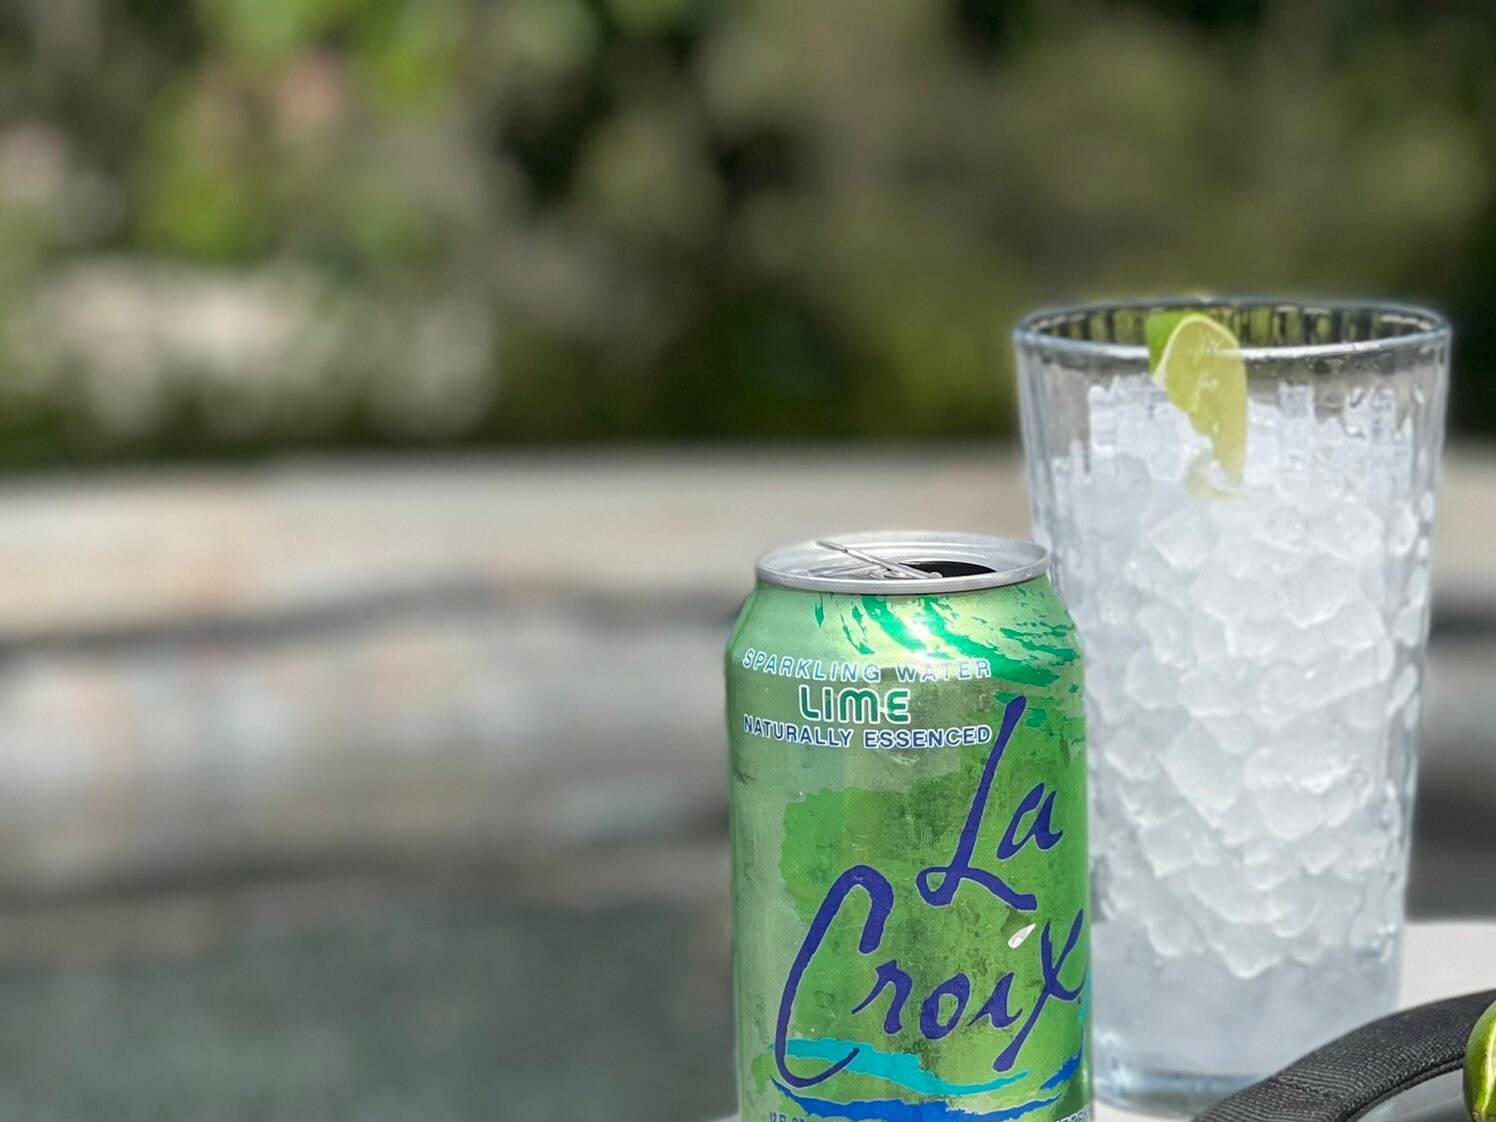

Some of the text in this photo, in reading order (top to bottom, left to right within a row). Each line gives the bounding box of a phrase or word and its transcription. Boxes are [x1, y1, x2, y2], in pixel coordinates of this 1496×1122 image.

[743, 648, 992, 682] SPARKLING WATER
[798, 684, 911, 724] LIME
[743, 713, 993, 749] NATURALLY ESSENCED
[916, 695, 1064, 911] La
[775, 864, 1087, 1089] Croix
